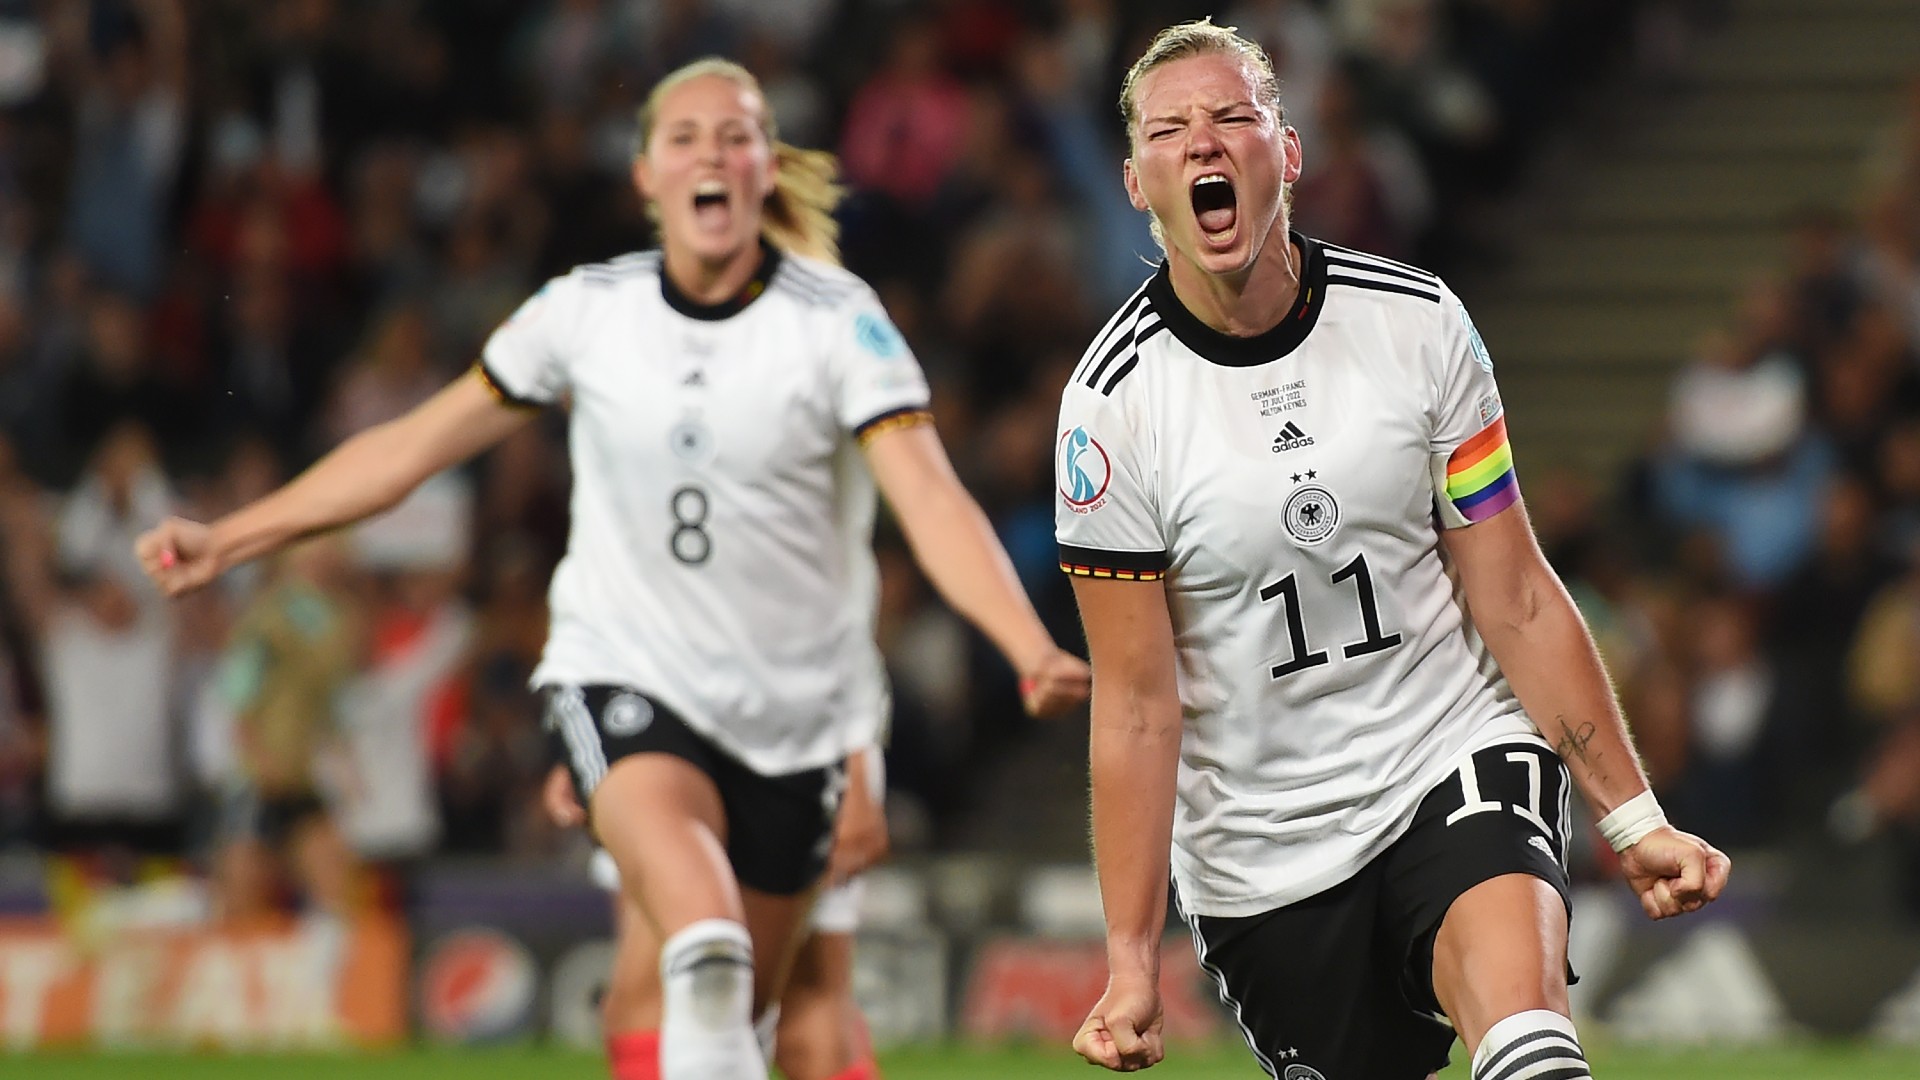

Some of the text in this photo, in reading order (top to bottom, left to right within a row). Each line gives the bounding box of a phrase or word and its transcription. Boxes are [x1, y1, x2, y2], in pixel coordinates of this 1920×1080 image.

[1250, 380, 1306, 400] GERMANY-FRANCE
[1261, 391, 1301, 408] 27 JULY 2022
[1260, 399, 1307, 416] MILTON KEYNES
[1272, 437, 1315, 453] adidas
[670, 485, 711, 566] 8
[1260, 553, 1402, 679] 11
[1446, 752, 1554, 841] 11
